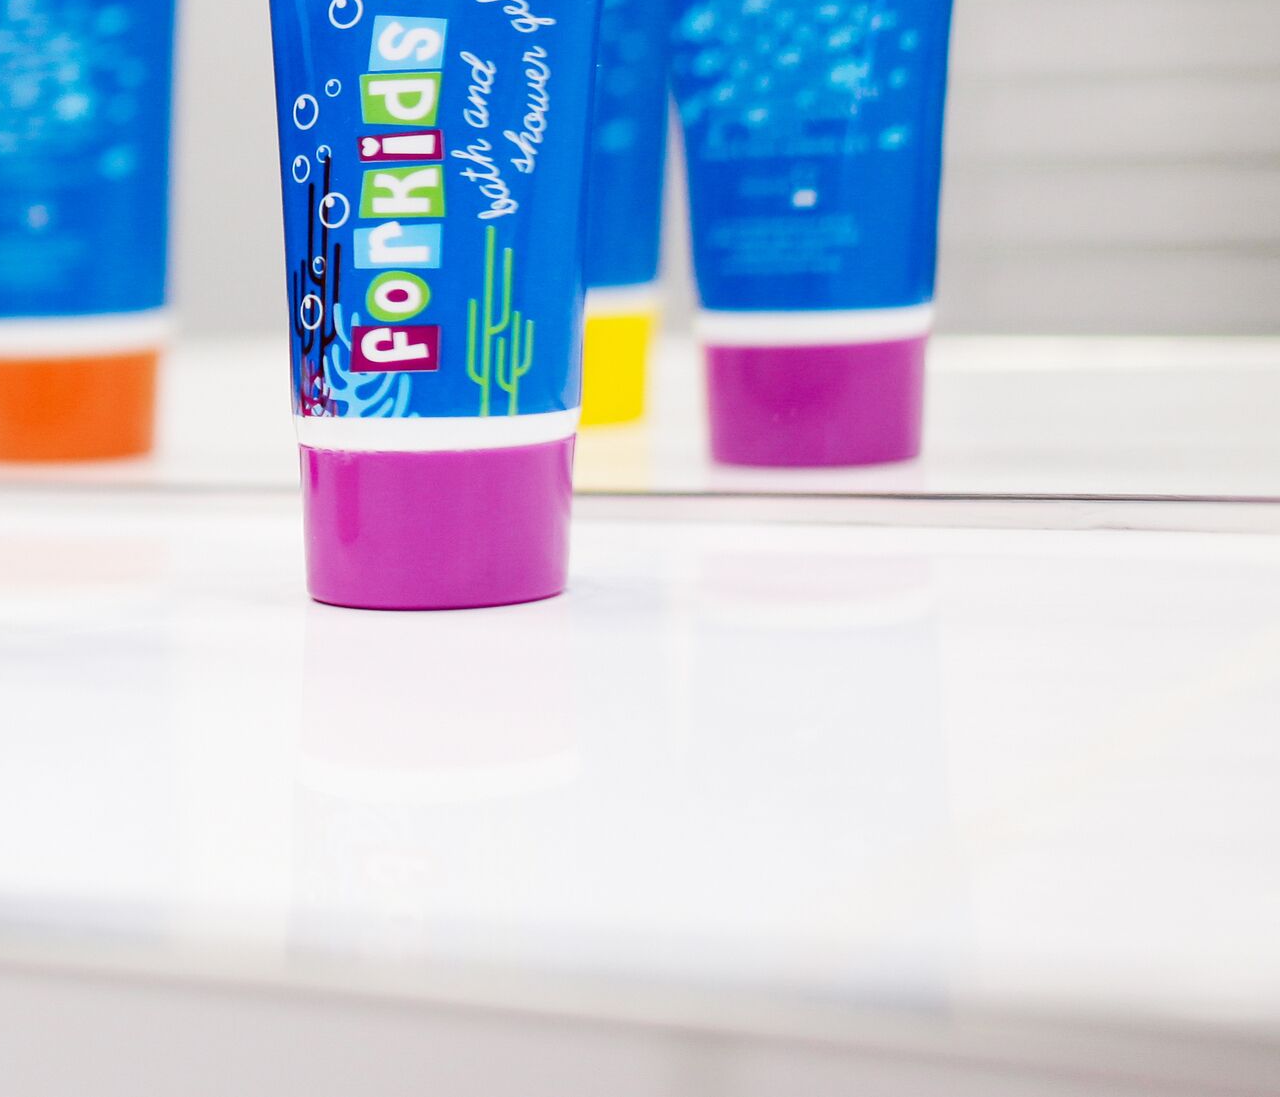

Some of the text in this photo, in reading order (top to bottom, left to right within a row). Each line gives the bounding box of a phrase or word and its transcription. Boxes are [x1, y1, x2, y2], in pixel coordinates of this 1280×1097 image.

[450, 50, 519, 220] bath and
[502, 45, 552, 175] shower
